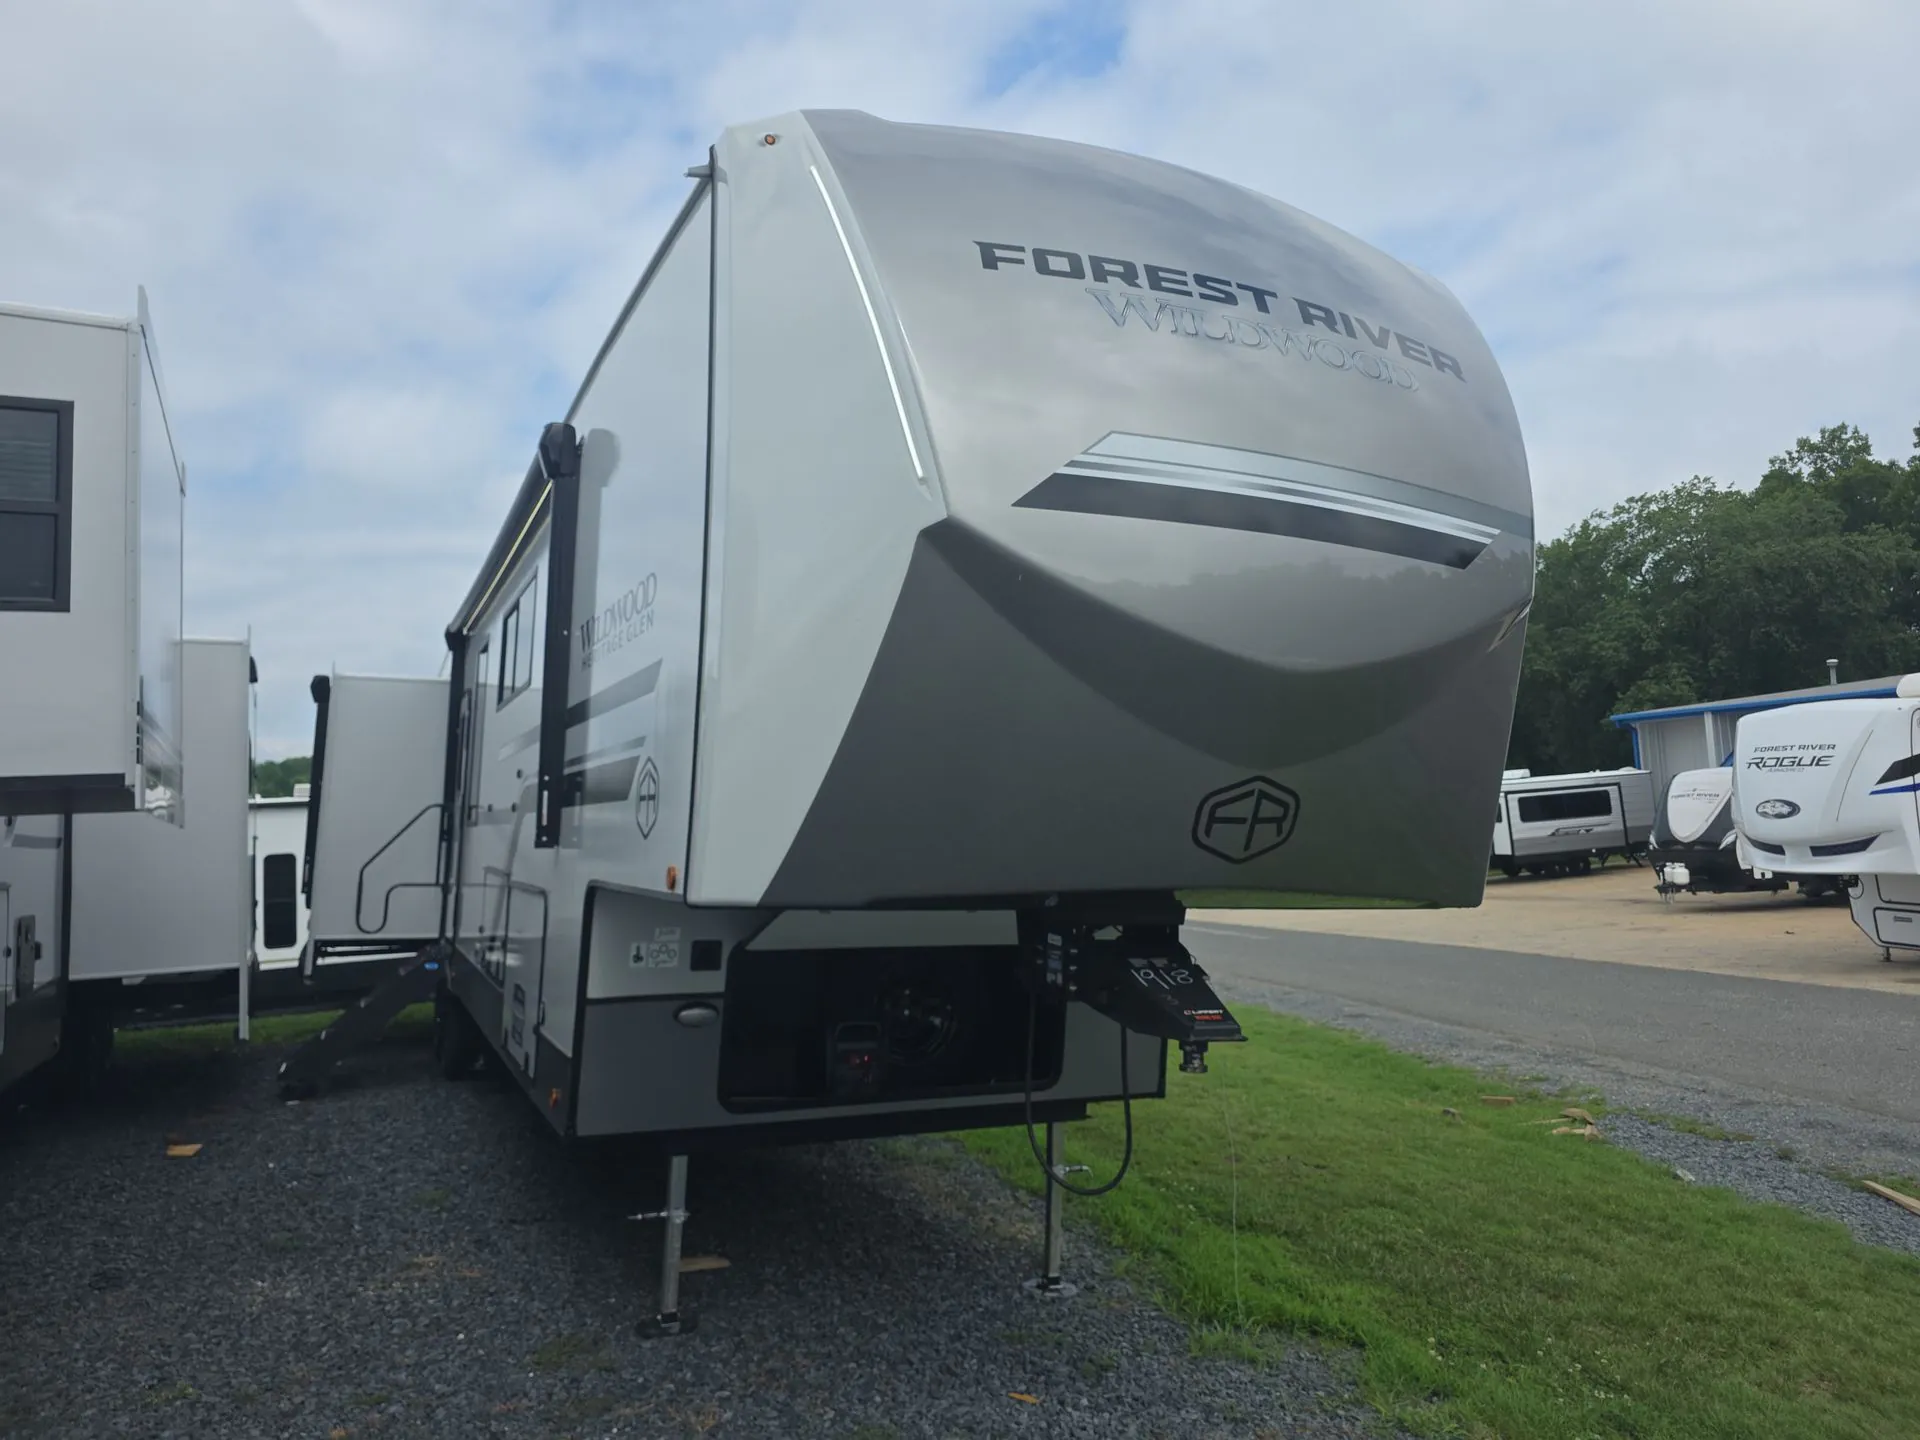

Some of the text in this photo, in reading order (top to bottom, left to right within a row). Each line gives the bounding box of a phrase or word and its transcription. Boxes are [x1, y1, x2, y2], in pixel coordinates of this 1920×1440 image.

[973, 240, 1467, 383] FOREST RIVER
[1085, 288, 1420, 392] WILDWOOD
[580, 572, 657, 653] WILDWOOD
[626, 609, 654, 642] GLEN
[1746, 755, 1835, 770] ROGUE
[1754, 745, 1795, 753] FOREST
